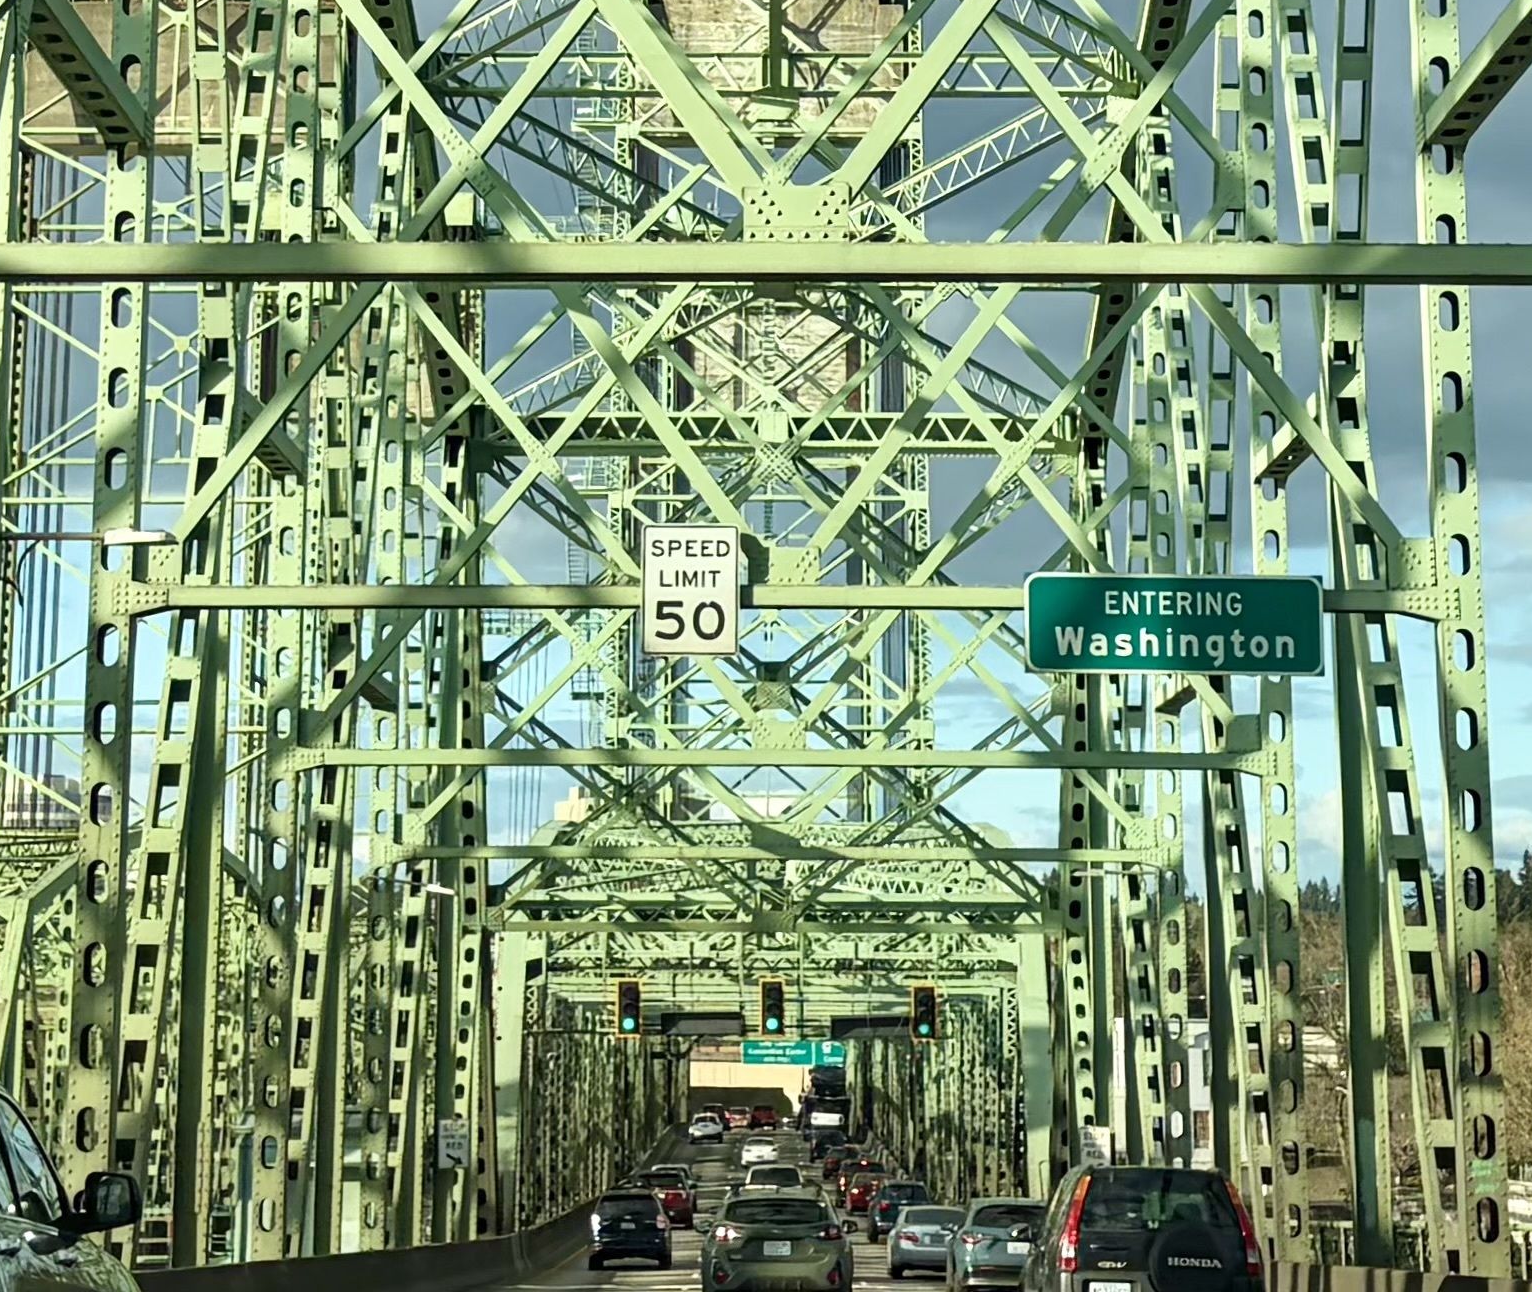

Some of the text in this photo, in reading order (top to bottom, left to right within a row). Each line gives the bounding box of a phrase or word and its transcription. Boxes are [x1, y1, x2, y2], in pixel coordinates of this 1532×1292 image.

[651, 539, 731, 558] SPEED
[659, 569, 721, 589] LIMIT
[1104, 590, 1243, 617] ENTERING
[654, 600, 726, 640] 50
[1055, 626, 1296, 667] Washington
[1167, 1257, 1222, 1268] HONDA
